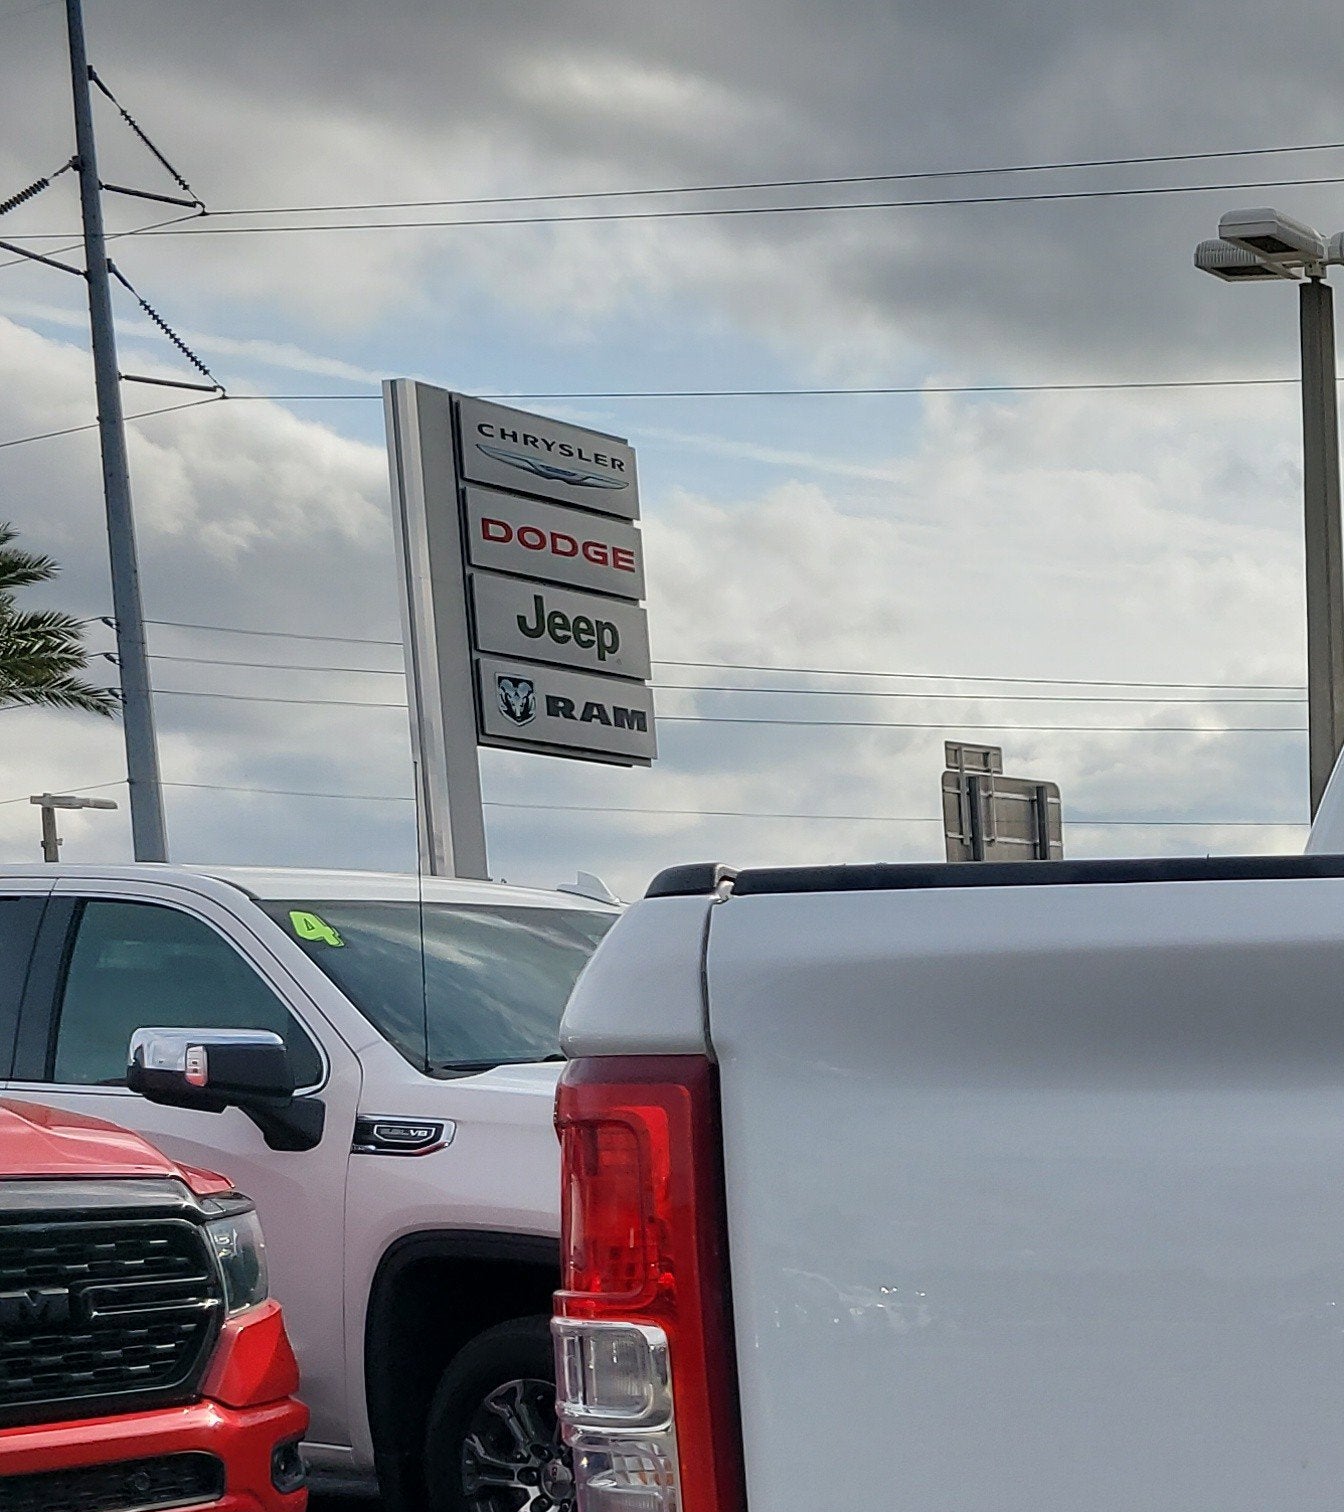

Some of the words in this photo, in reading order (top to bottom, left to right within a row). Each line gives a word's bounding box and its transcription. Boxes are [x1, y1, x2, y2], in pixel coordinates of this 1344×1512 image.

[477, 422, 626, 473] CHRYSLER
[481, 517, 637, 573] DODGE
[516, 595, 620, 661] Jeep
[545, 694, 648, 733] RAM
[289, 910, 344, 947] 4
